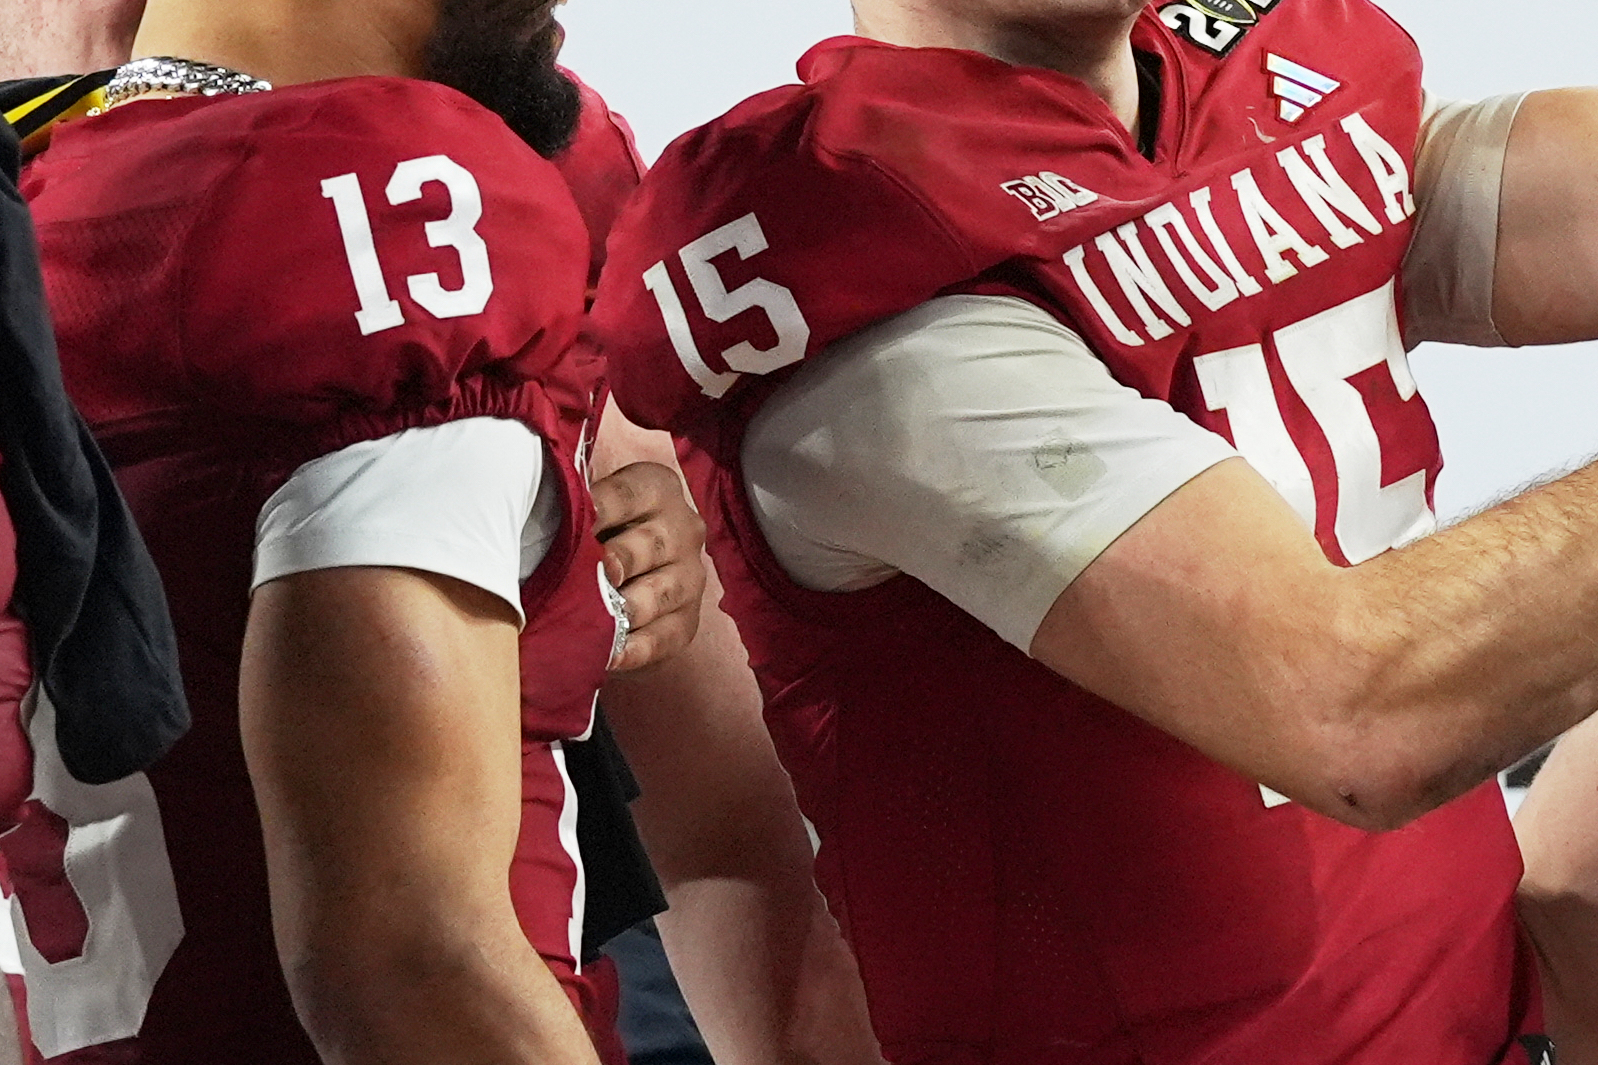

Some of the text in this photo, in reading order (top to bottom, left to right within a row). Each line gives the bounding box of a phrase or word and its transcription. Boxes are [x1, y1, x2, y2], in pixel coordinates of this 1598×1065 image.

[320, 154, 494, 335] 13
[642, 212, 811, 400] 15
[1063, 112, 1415, 348] INDIANA
